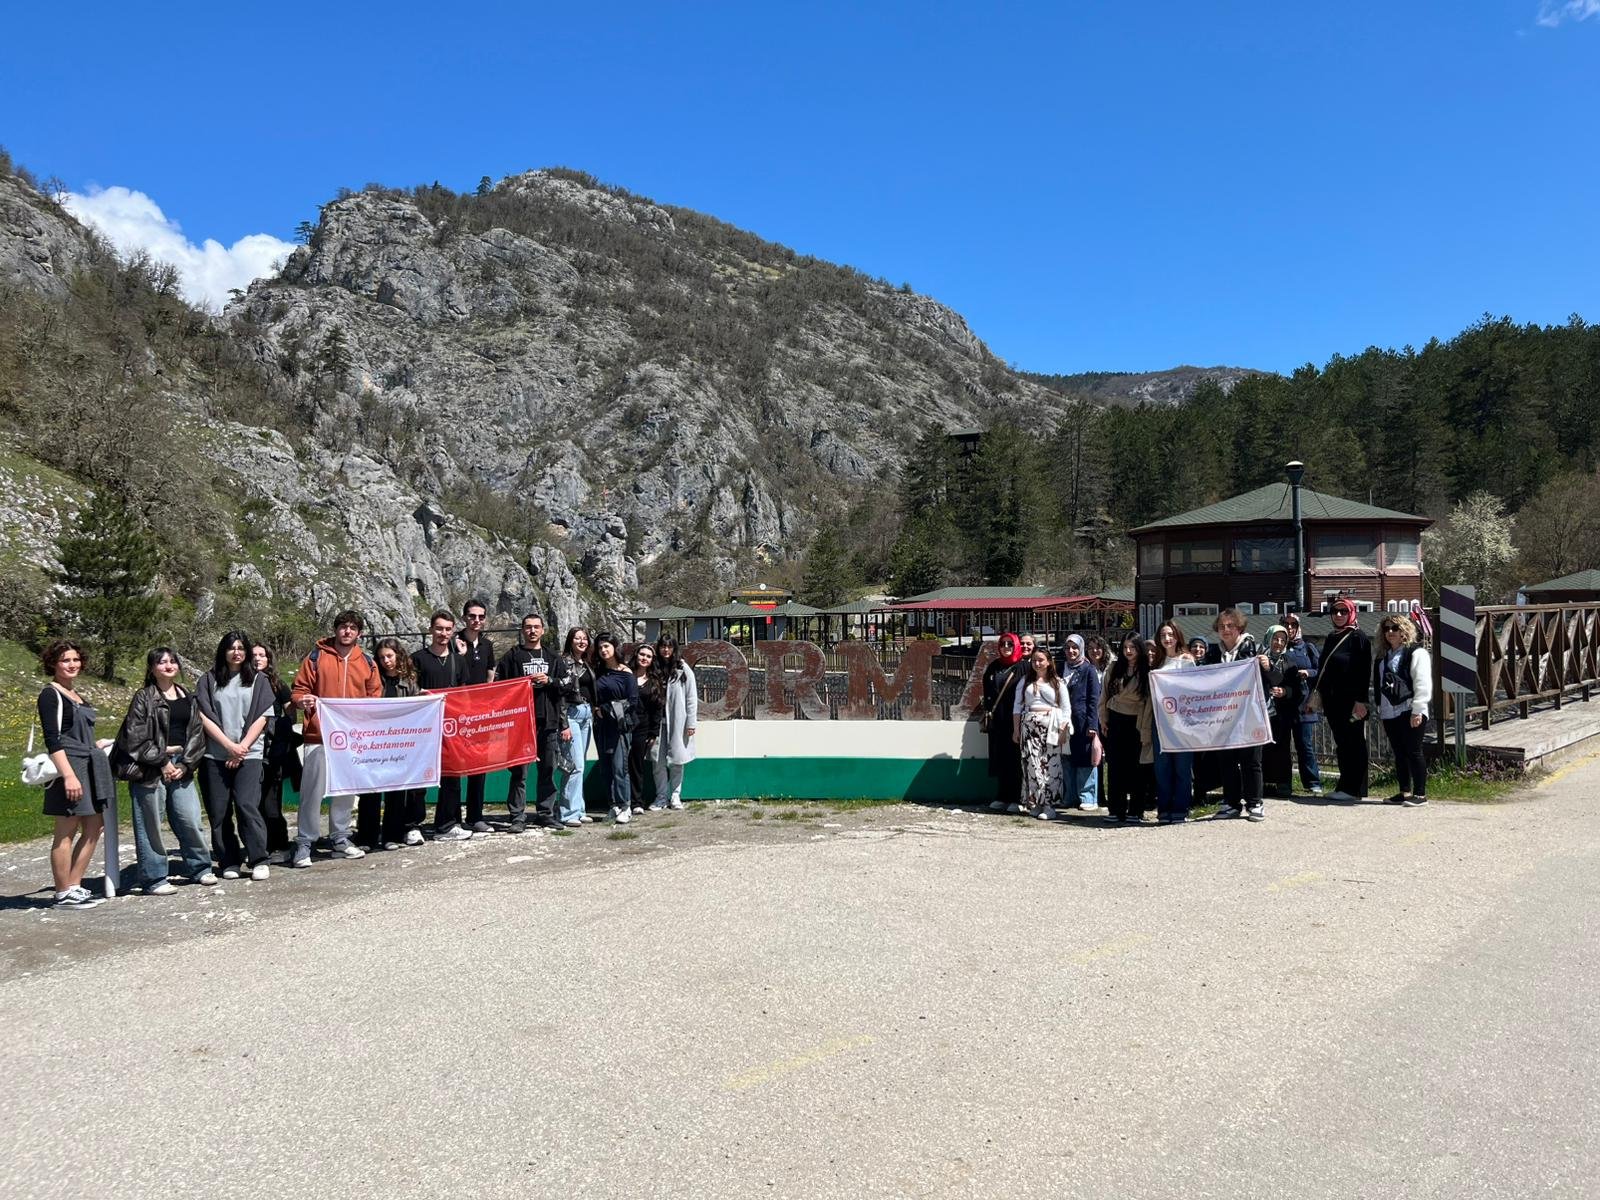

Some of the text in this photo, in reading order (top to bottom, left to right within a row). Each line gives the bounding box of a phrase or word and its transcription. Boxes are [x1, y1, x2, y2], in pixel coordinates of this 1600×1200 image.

[458, 706, 528, 725] @gezsen.kastamonu
[349, 726, 432, 740] @gezsen.kastamonu
[459, 721, 515, 737] @go.kastamonu
[350, 740, 416, 753] @go.kastamonu
